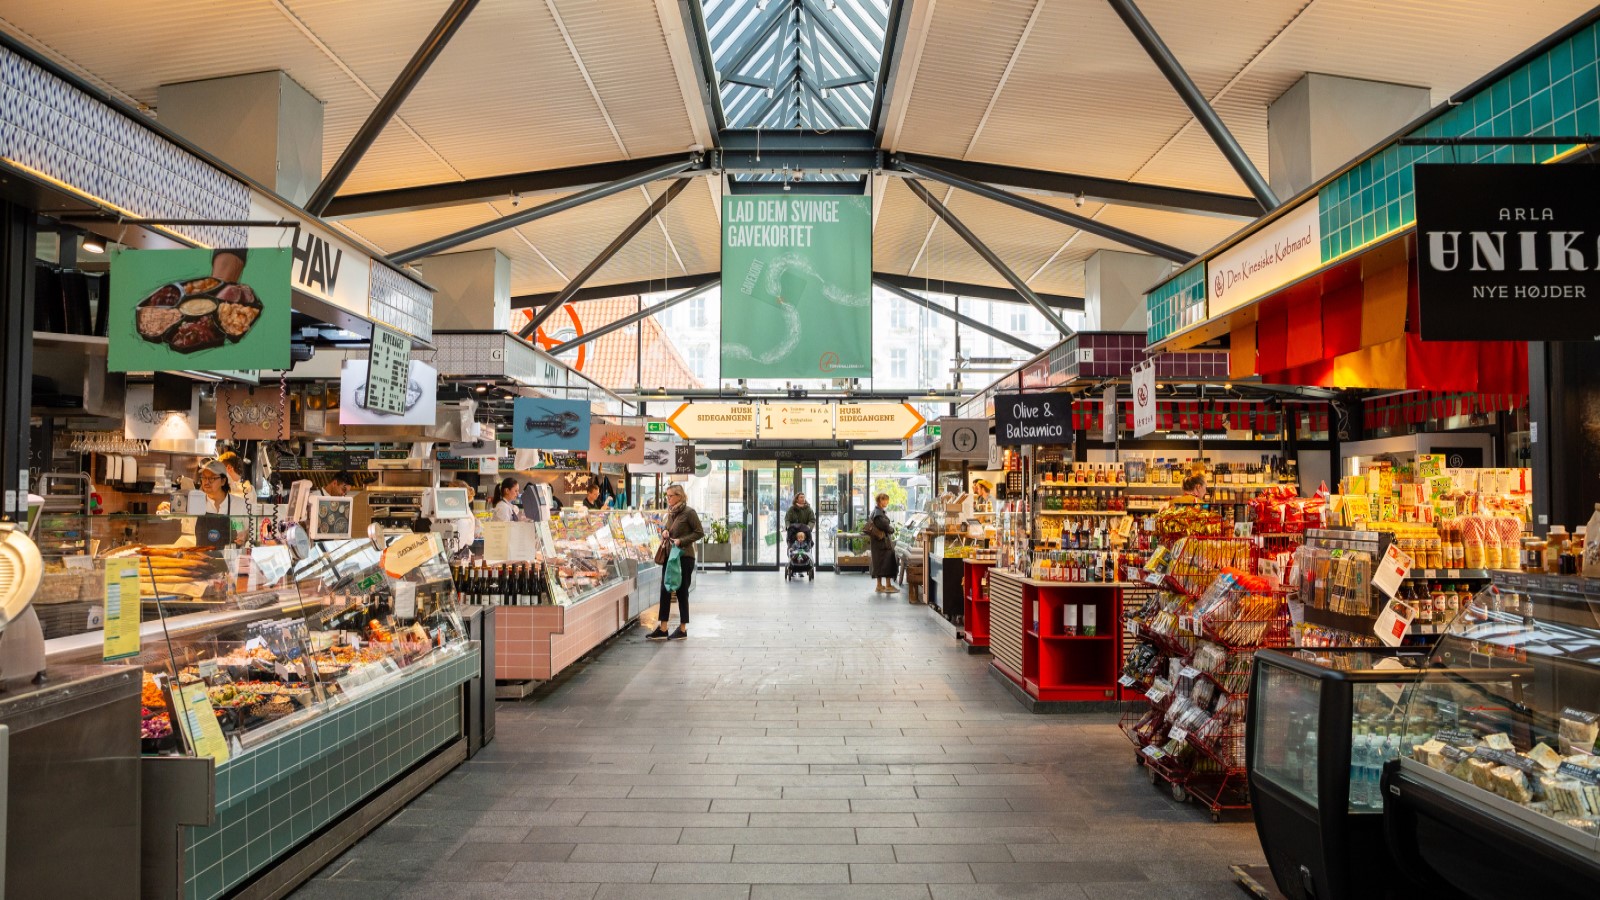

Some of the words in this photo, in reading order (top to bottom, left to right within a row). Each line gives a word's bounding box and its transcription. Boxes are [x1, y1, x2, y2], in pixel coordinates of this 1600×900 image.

[728, 200, 753, 222] LAD
[758, 200, 787, 222] DEM
[791, 200, 839, 222] SVINGE
[1498, 208, 1554, 221] ARLA
[728, 225, 813, 247] GAVEKORTET
[1227, 270, 1241, 290] Den
[1241, 250, 1274, 280] Kinesiske
[1274, 225, 1311, 264] Købmand
[1426, 231, 1600, 271] UNIK
[291, 226, 342, 297] HAV
[741, 258, 764, 295] GAVEKORT
[1473, 286, 1509, 298] NYE
[1514, 286, 1587, 298] HØJDER
[492, 350, 501, 360] G
[1084, 350, 1091, 360] F
[697, 414, 753, 422] SIDEGANGENE
[1012, 403, 1039, 419] Olive
[1043, 402, 1054, 417] &
[765, 415, 773, 430] 1
[1006, 423, 1063, 440] Balsamico
[675, 465, 692, 474] ips
